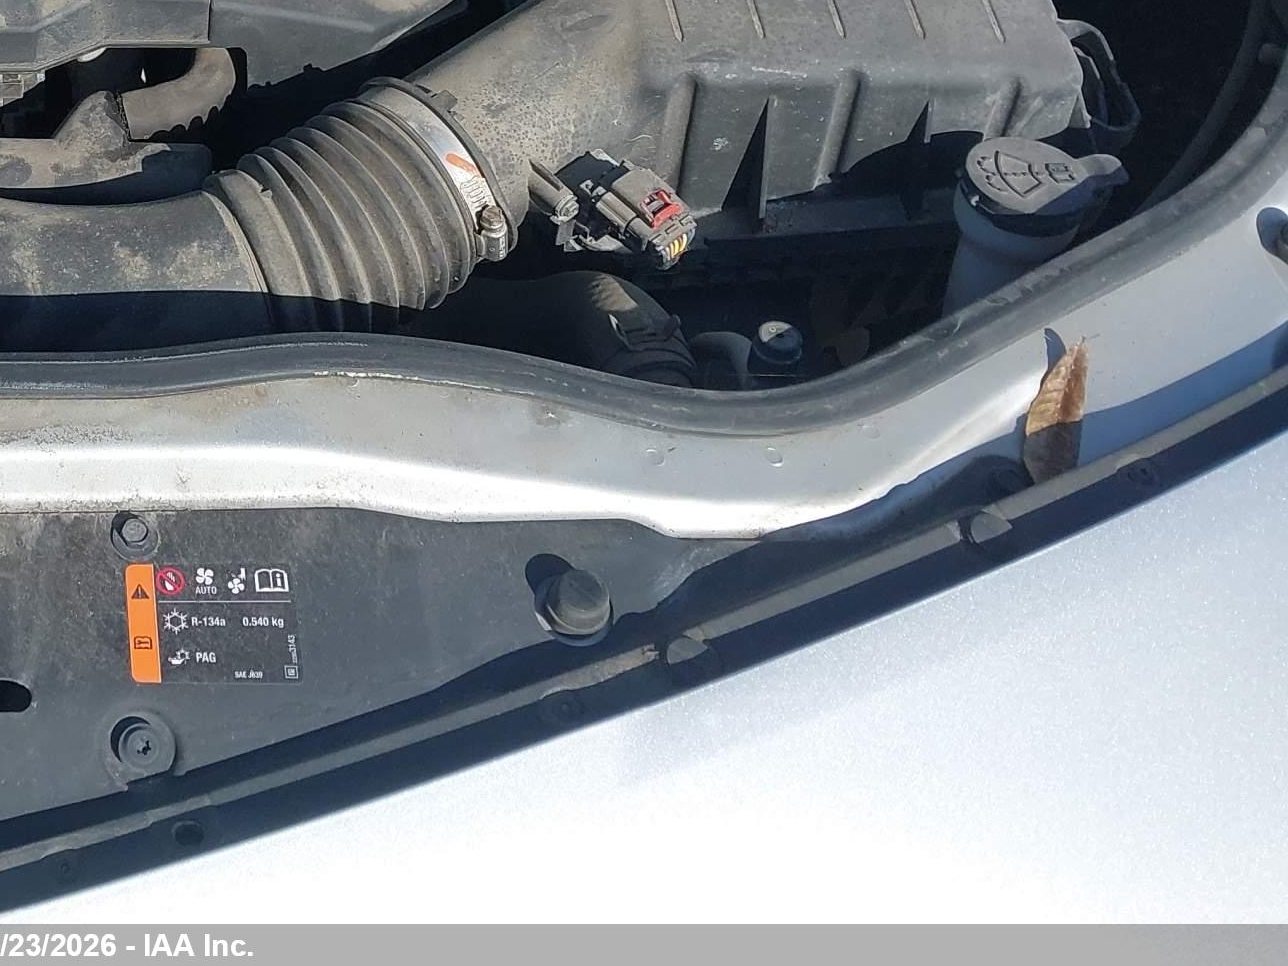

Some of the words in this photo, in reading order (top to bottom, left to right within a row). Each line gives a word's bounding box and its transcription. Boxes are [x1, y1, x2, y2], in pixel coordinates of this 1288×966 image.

[195, 586, 217, 595] AUTO
[191, 617, 226, 626] R-134a
[242, 617, 269, 626] 0.540
[271, 617, 284, 628] kg
[195, 652, 217, 663] PAG
